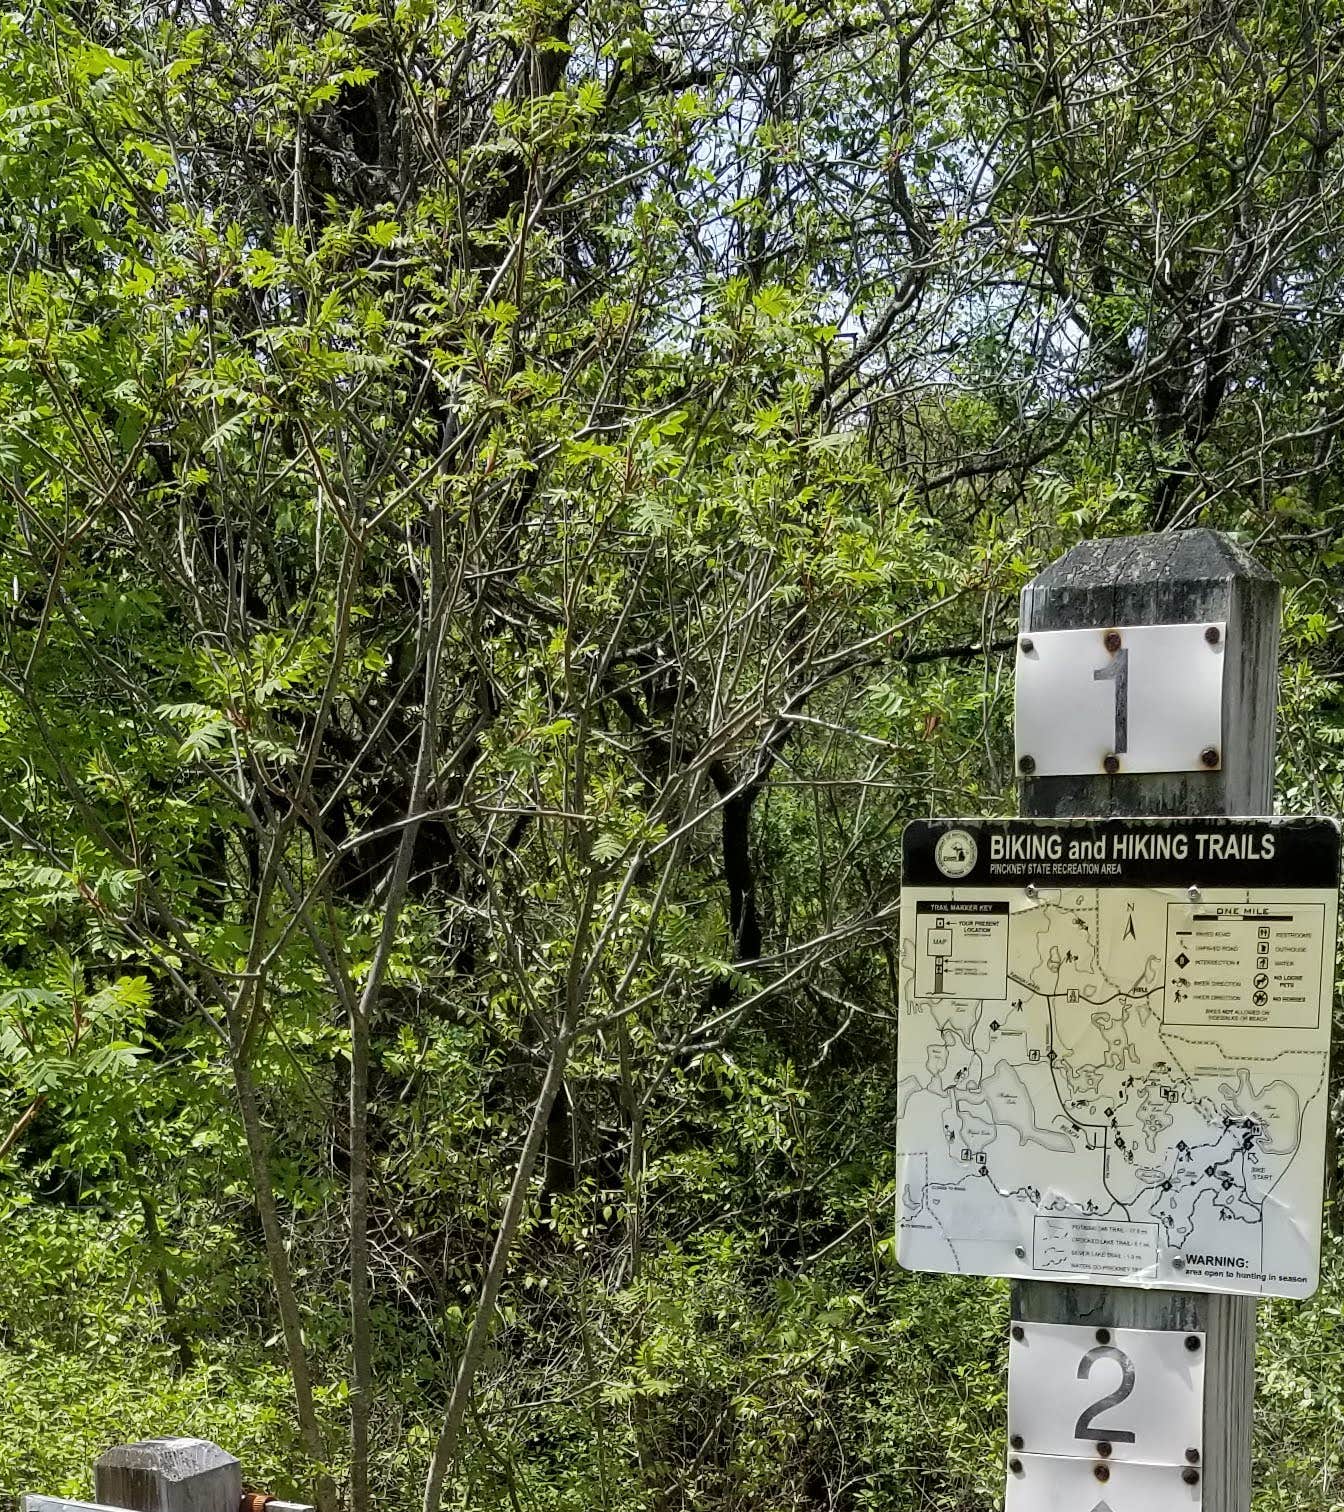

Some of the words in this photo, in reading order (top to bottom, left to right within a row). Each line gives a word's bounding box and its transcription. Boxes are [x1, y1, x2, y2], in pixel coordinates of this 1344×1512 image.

[1094, 648, 1128, 754] 1
[990, 835, 1062, 860] BIKING
[1068, 835, 1106, 860] and
[1112, 834, 1189, 860] HIKING
[1195, 833, 1276, 860] TRAILS
[990, 863, 1026, 875] PINCKNEY
[1027, 863, 1051, 875] STATE
[1052, 863, 1099, 875] RECREATION
[1101, 863, 1122, 875] AREA
[1127, 903, 1135, 912] N
[1186, 1254, 1249, 1268] WARNING:
[1204, 1270, 1224, 1279] open
[1236, 1271, 1267, 1282] hunting
[1074, 1345, 1136, 1444] 2
